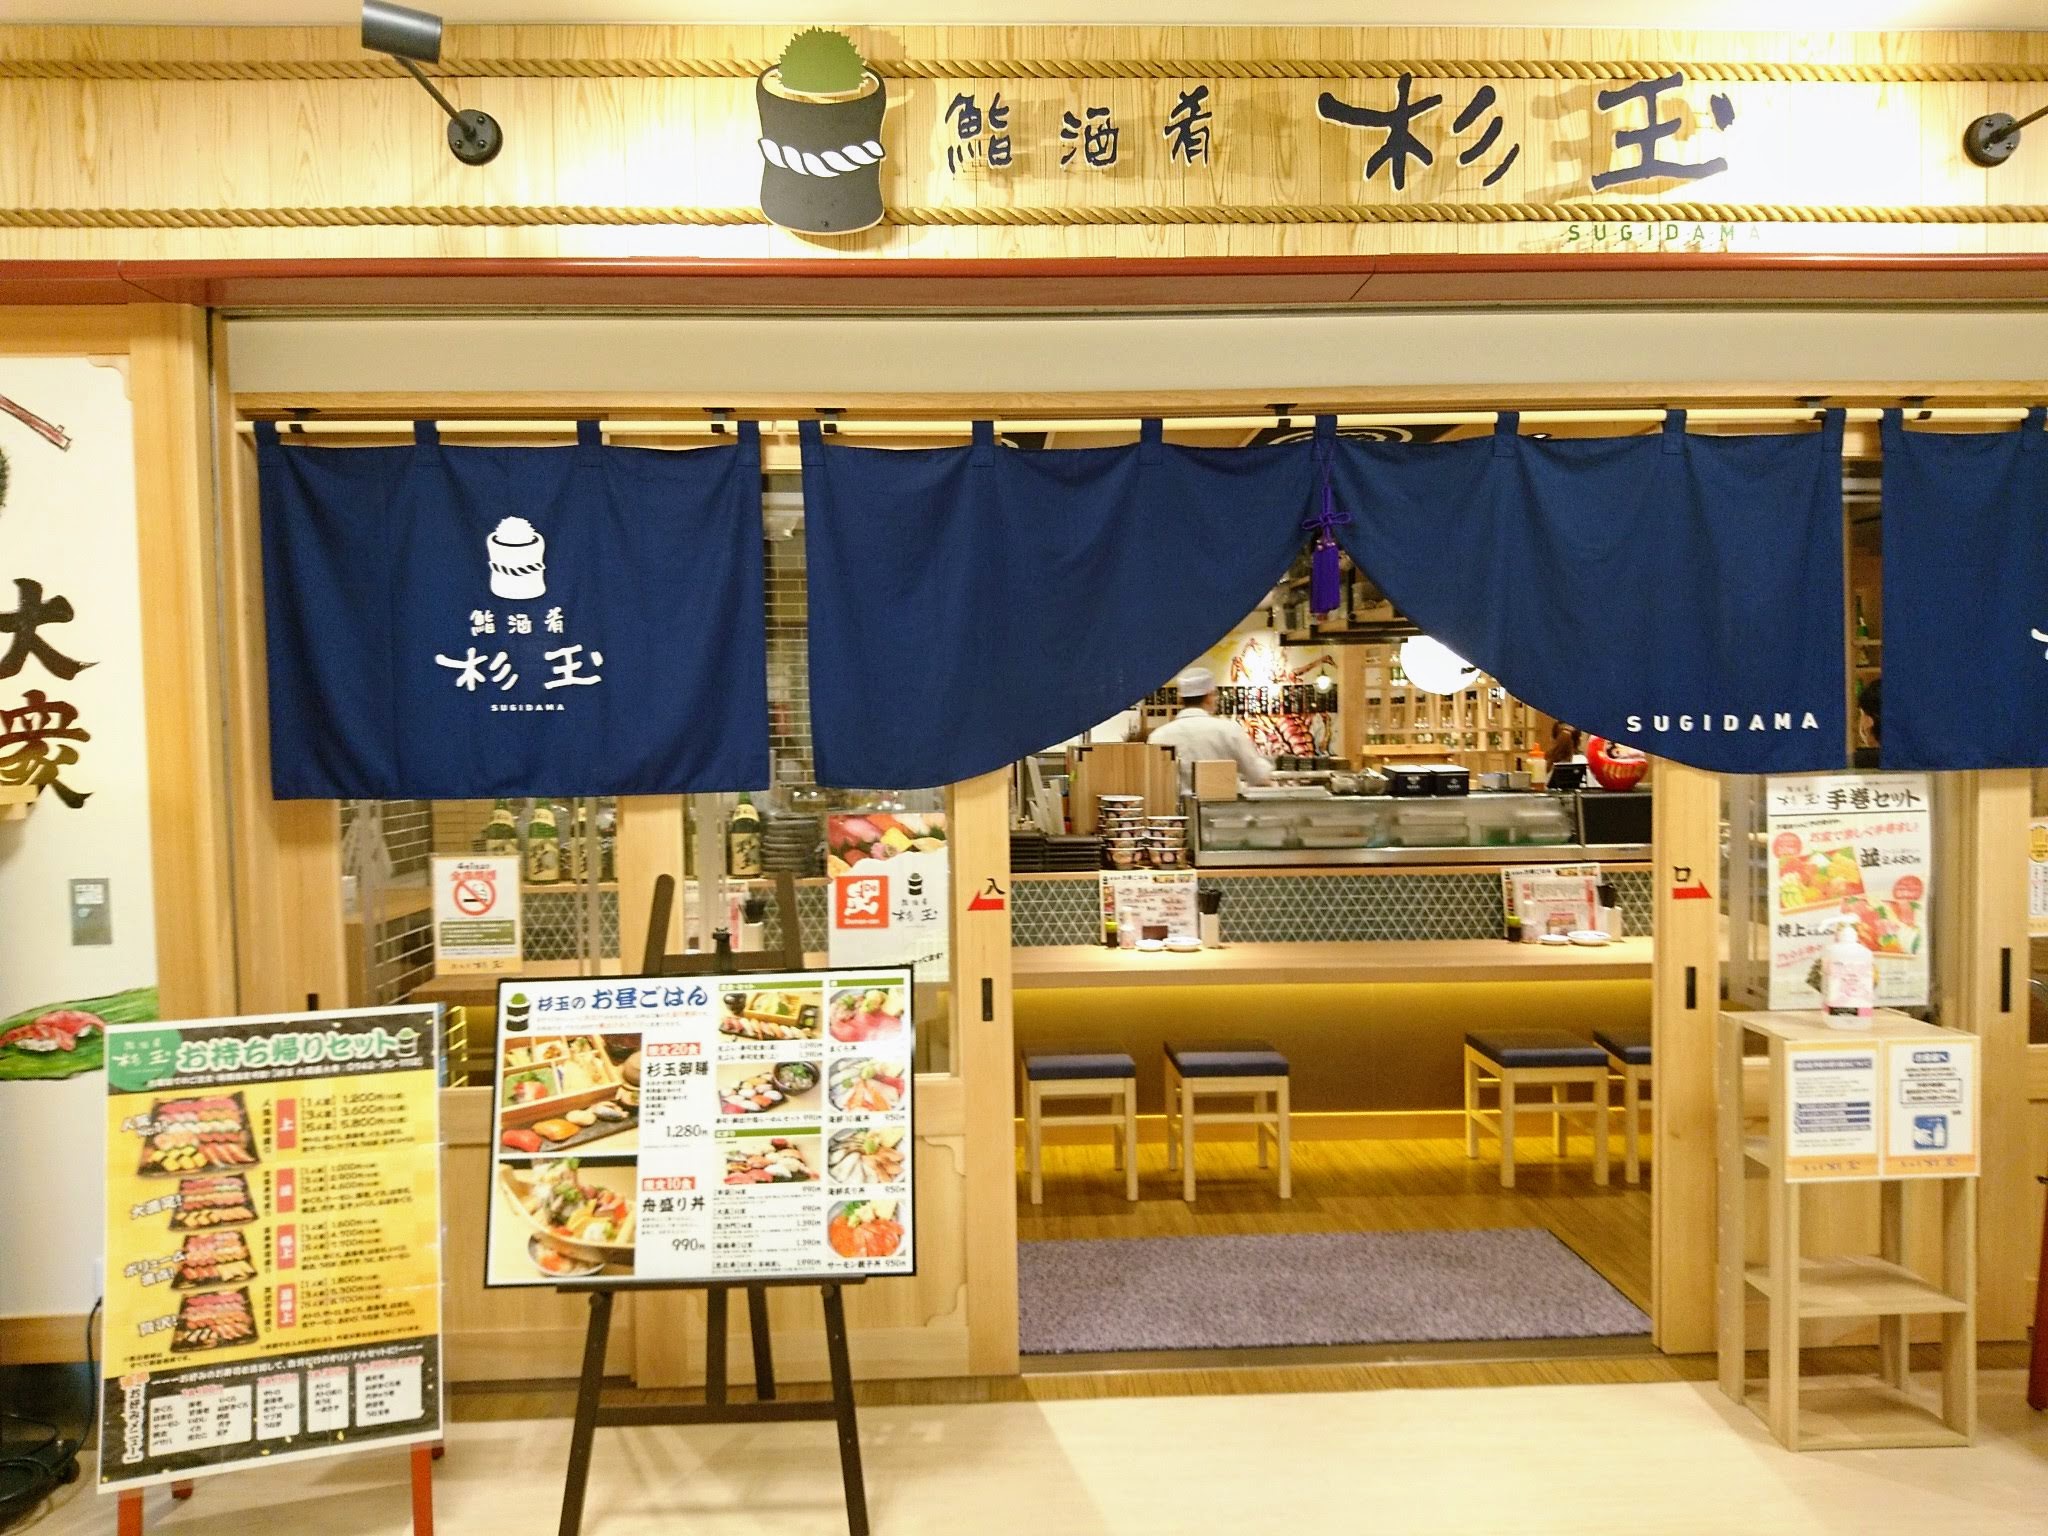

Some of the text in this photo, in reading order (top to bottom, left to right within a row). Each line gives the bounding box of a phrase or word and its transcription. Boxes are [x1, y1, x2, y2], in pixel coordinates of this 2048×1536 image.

[944, 85, 1214, 176] 鮨酒肴
[1316, 72, 1736, 194] 杉玉
[1568, 224, 1761, 241] SUGIDAMA
[470, 607, 565, 637] 鮨酒肴
[434, 644, 604, 692] 杉玉
[490, 704, 566, 712] SUGIDAMA
[1626, 712, 1819, 733] SUGIDAMA
[1827, 787, 1921, 810] 手巻セット
[1673, 865, 1691, 882] 口
[984, 877, 1006, 896] 入
[537, 985, 709, 1012] 杉玉のお昼ごはん
[177, 1027, 399, 1072] お持ち帰りセット
